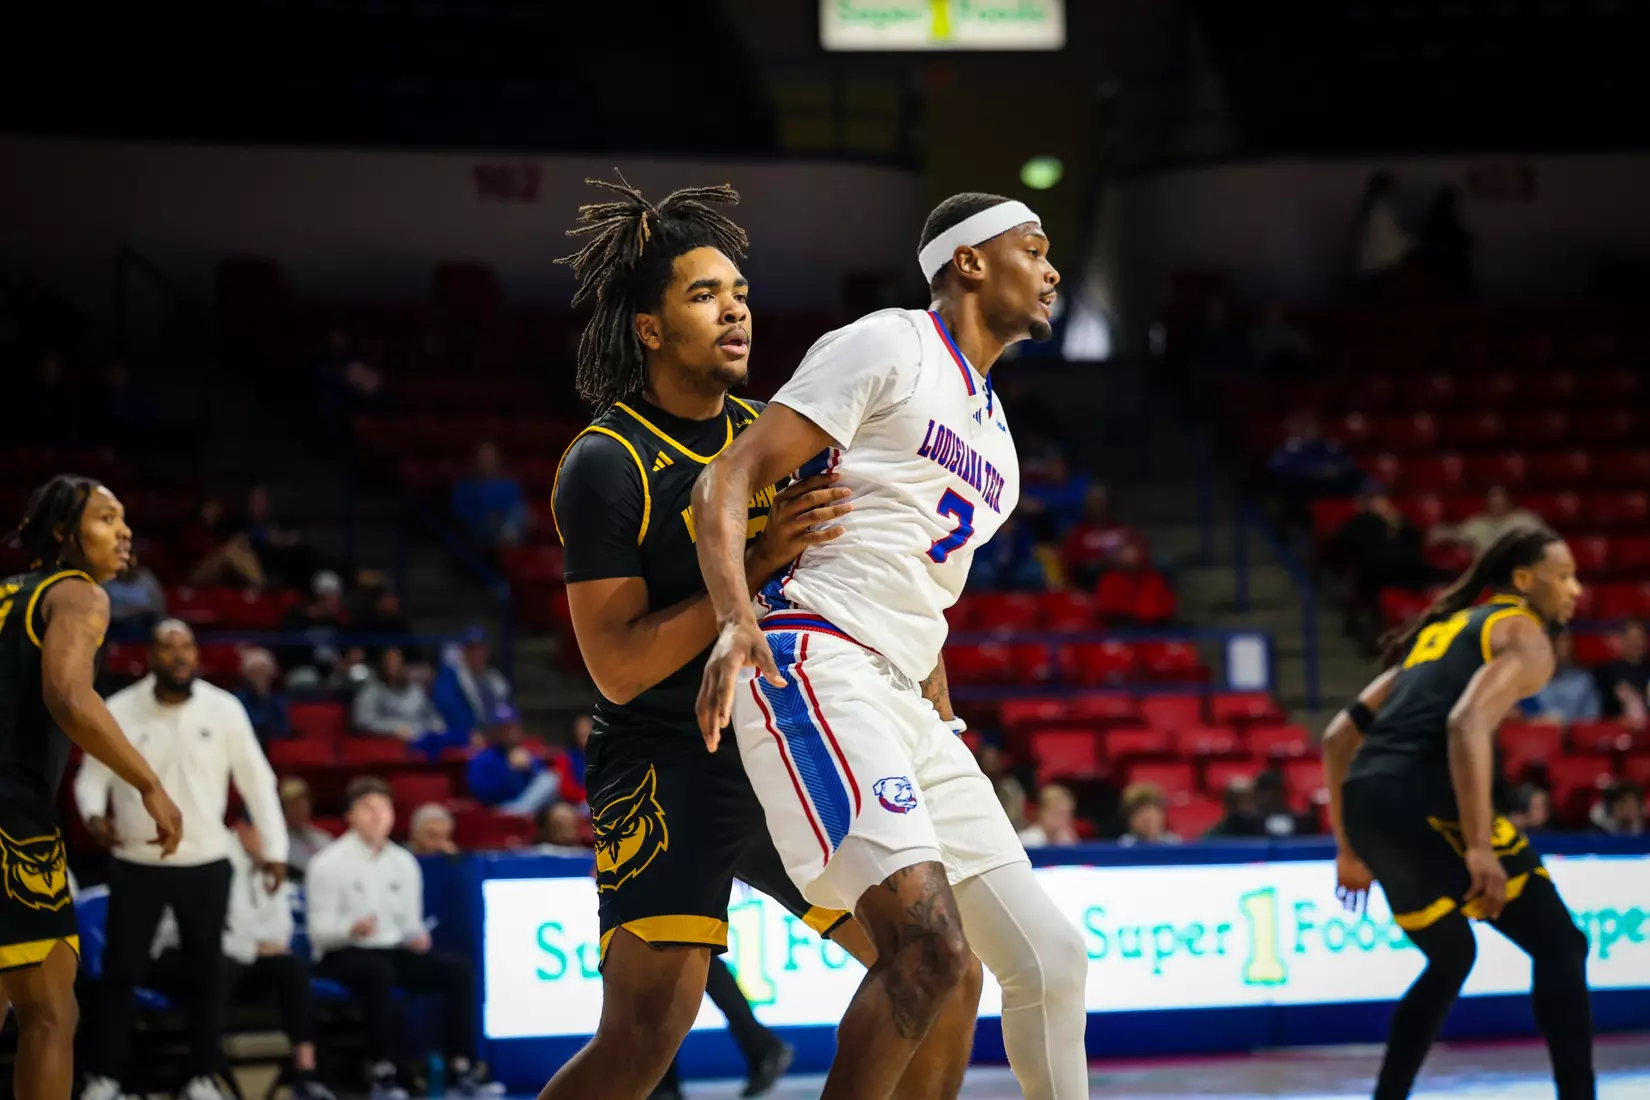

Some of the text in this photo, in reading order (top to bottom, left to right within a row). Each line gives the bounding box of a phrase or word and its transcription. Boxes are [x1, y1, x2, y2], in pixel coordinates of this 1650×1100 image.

[917, 418, 1006, 514] LOUISIANA TECH
[1084, 905, 1232, 974] Super
[1240, 885, 1288, 986] 1
